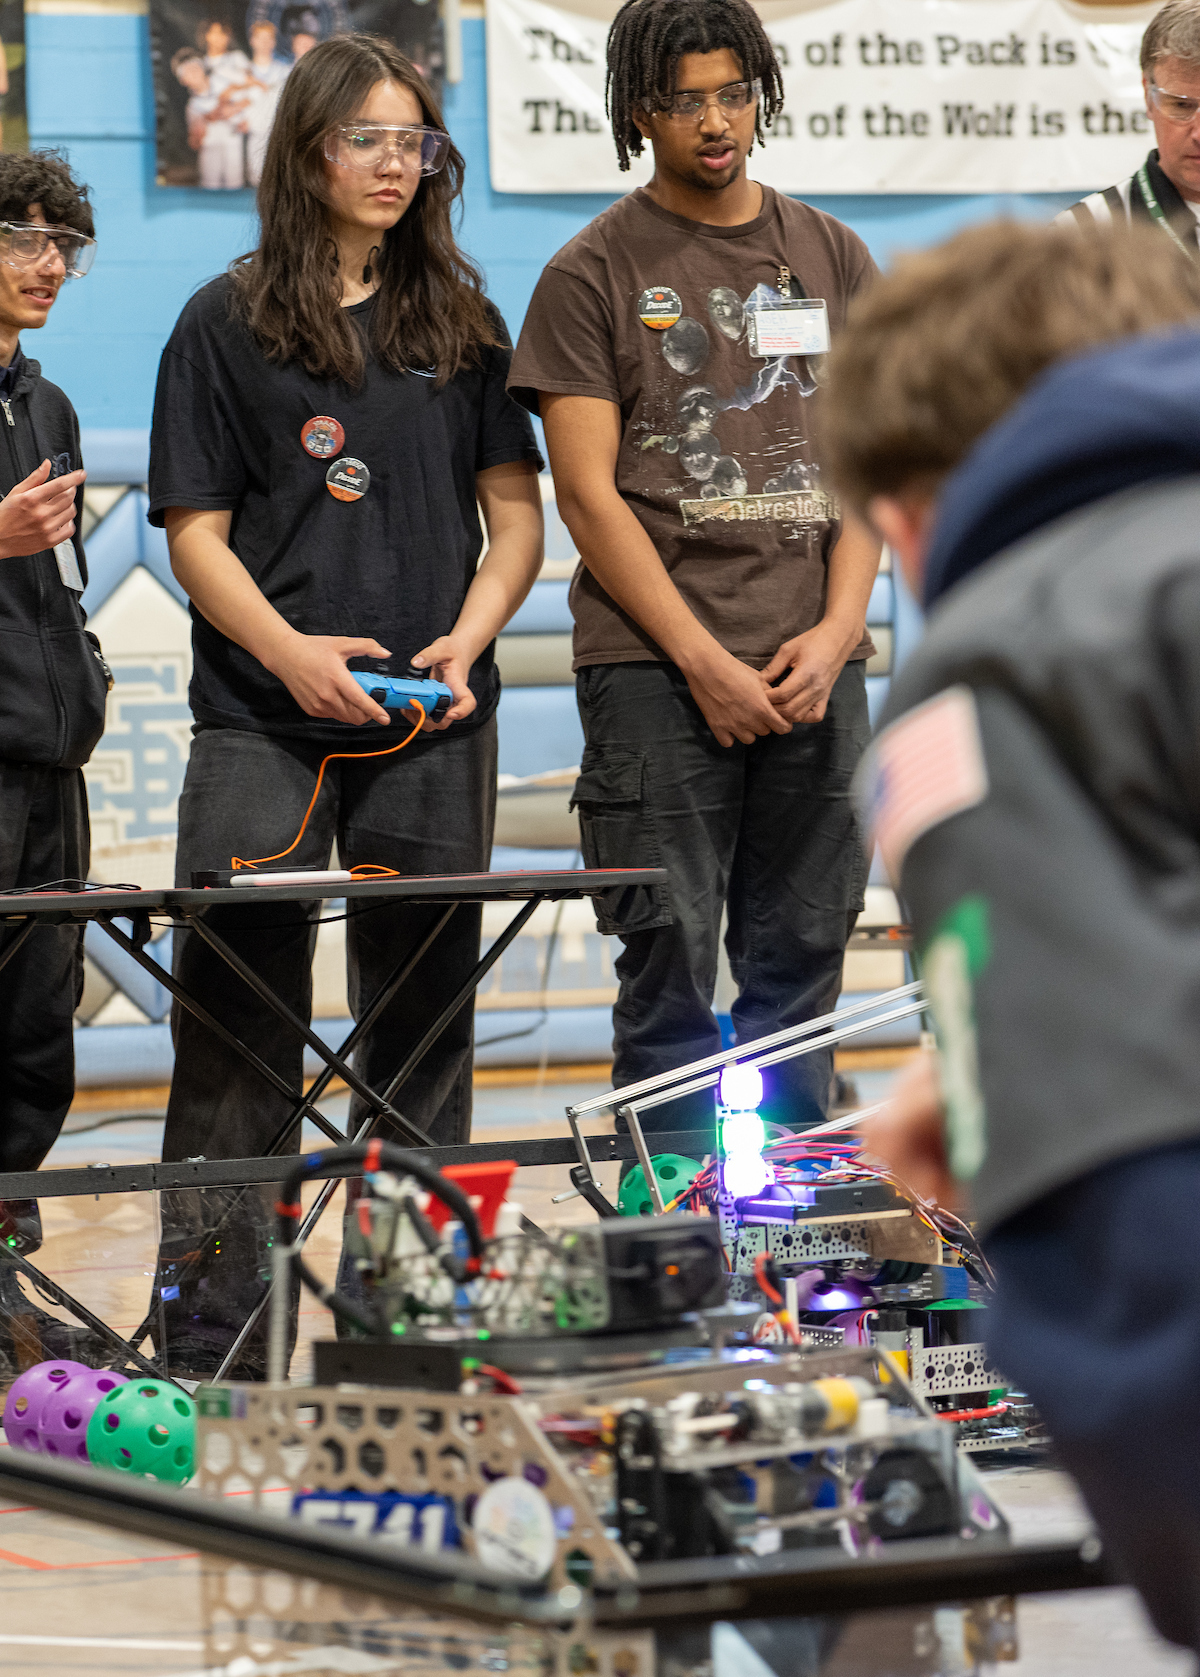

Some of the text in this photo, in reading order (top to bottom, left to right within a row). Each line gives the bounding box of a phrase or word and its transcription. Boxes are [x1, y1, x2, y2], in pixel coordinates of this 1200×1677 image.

[804, 33, 843, 66] of
[858, 33, 925, 66] the
[934, 33, 1027, 66] Pack
[1040, 33, 1077, 66] is
[808, 104, 847, 138] of
[863, 102, 930, 137] the
[943, 101, 1016, 138] Wolf
[1030, 102, 1065, 137] is
[1082, 102, 1151, 135] the
